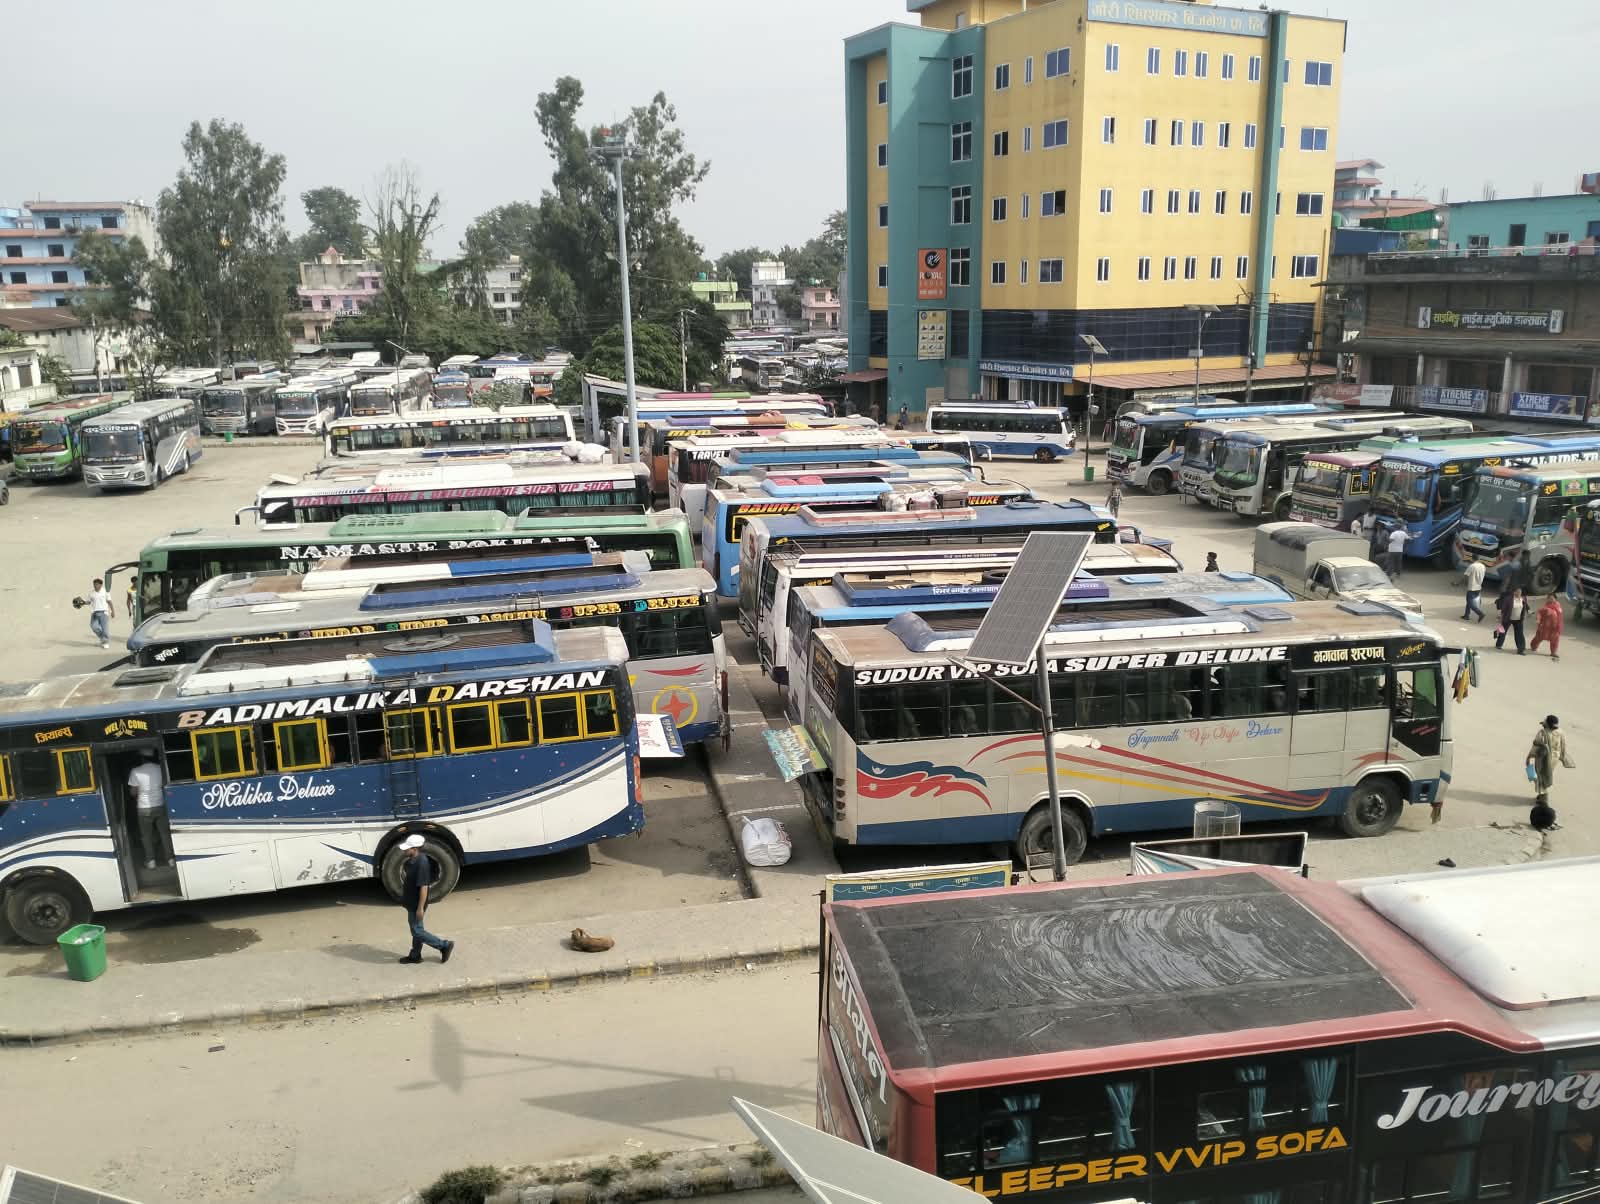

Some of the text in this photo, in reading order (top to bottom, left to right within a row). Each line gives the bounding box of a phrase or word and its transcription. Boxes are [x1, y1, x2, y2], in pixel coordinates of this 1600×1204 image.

[1440, 388, 1473, 400] XTREME
[1519, 393, 1550, 405] XTREME
[1504, 456, 1547, 467] RYAL
[558, 482, 580, 493] VIP
[281, 536, 601, 560] NAMASTE POKA
[560, 603, 622, 619] SUPER
[634, 595, 700, 612] DELUXE
[854, 666, 946, 685] SUDUR
[1064, 648, 1169, 672] SUPER
[1175, 646, 1288, 668] DELUXE
[1313, 648, 1349, 663] भगवान
[177, 670, 606, 728] BADIMALIKA DARSHAN
[1246, 720, 1283, 738] Deluxe
[202, 775, 336, 810] Malika Deluxe
[1377, 1071, 1600, 1129] Journey
[1155, 1140, 1246, 1175] VVIP
[1256, 1127, 1348, 1161] SOFA
